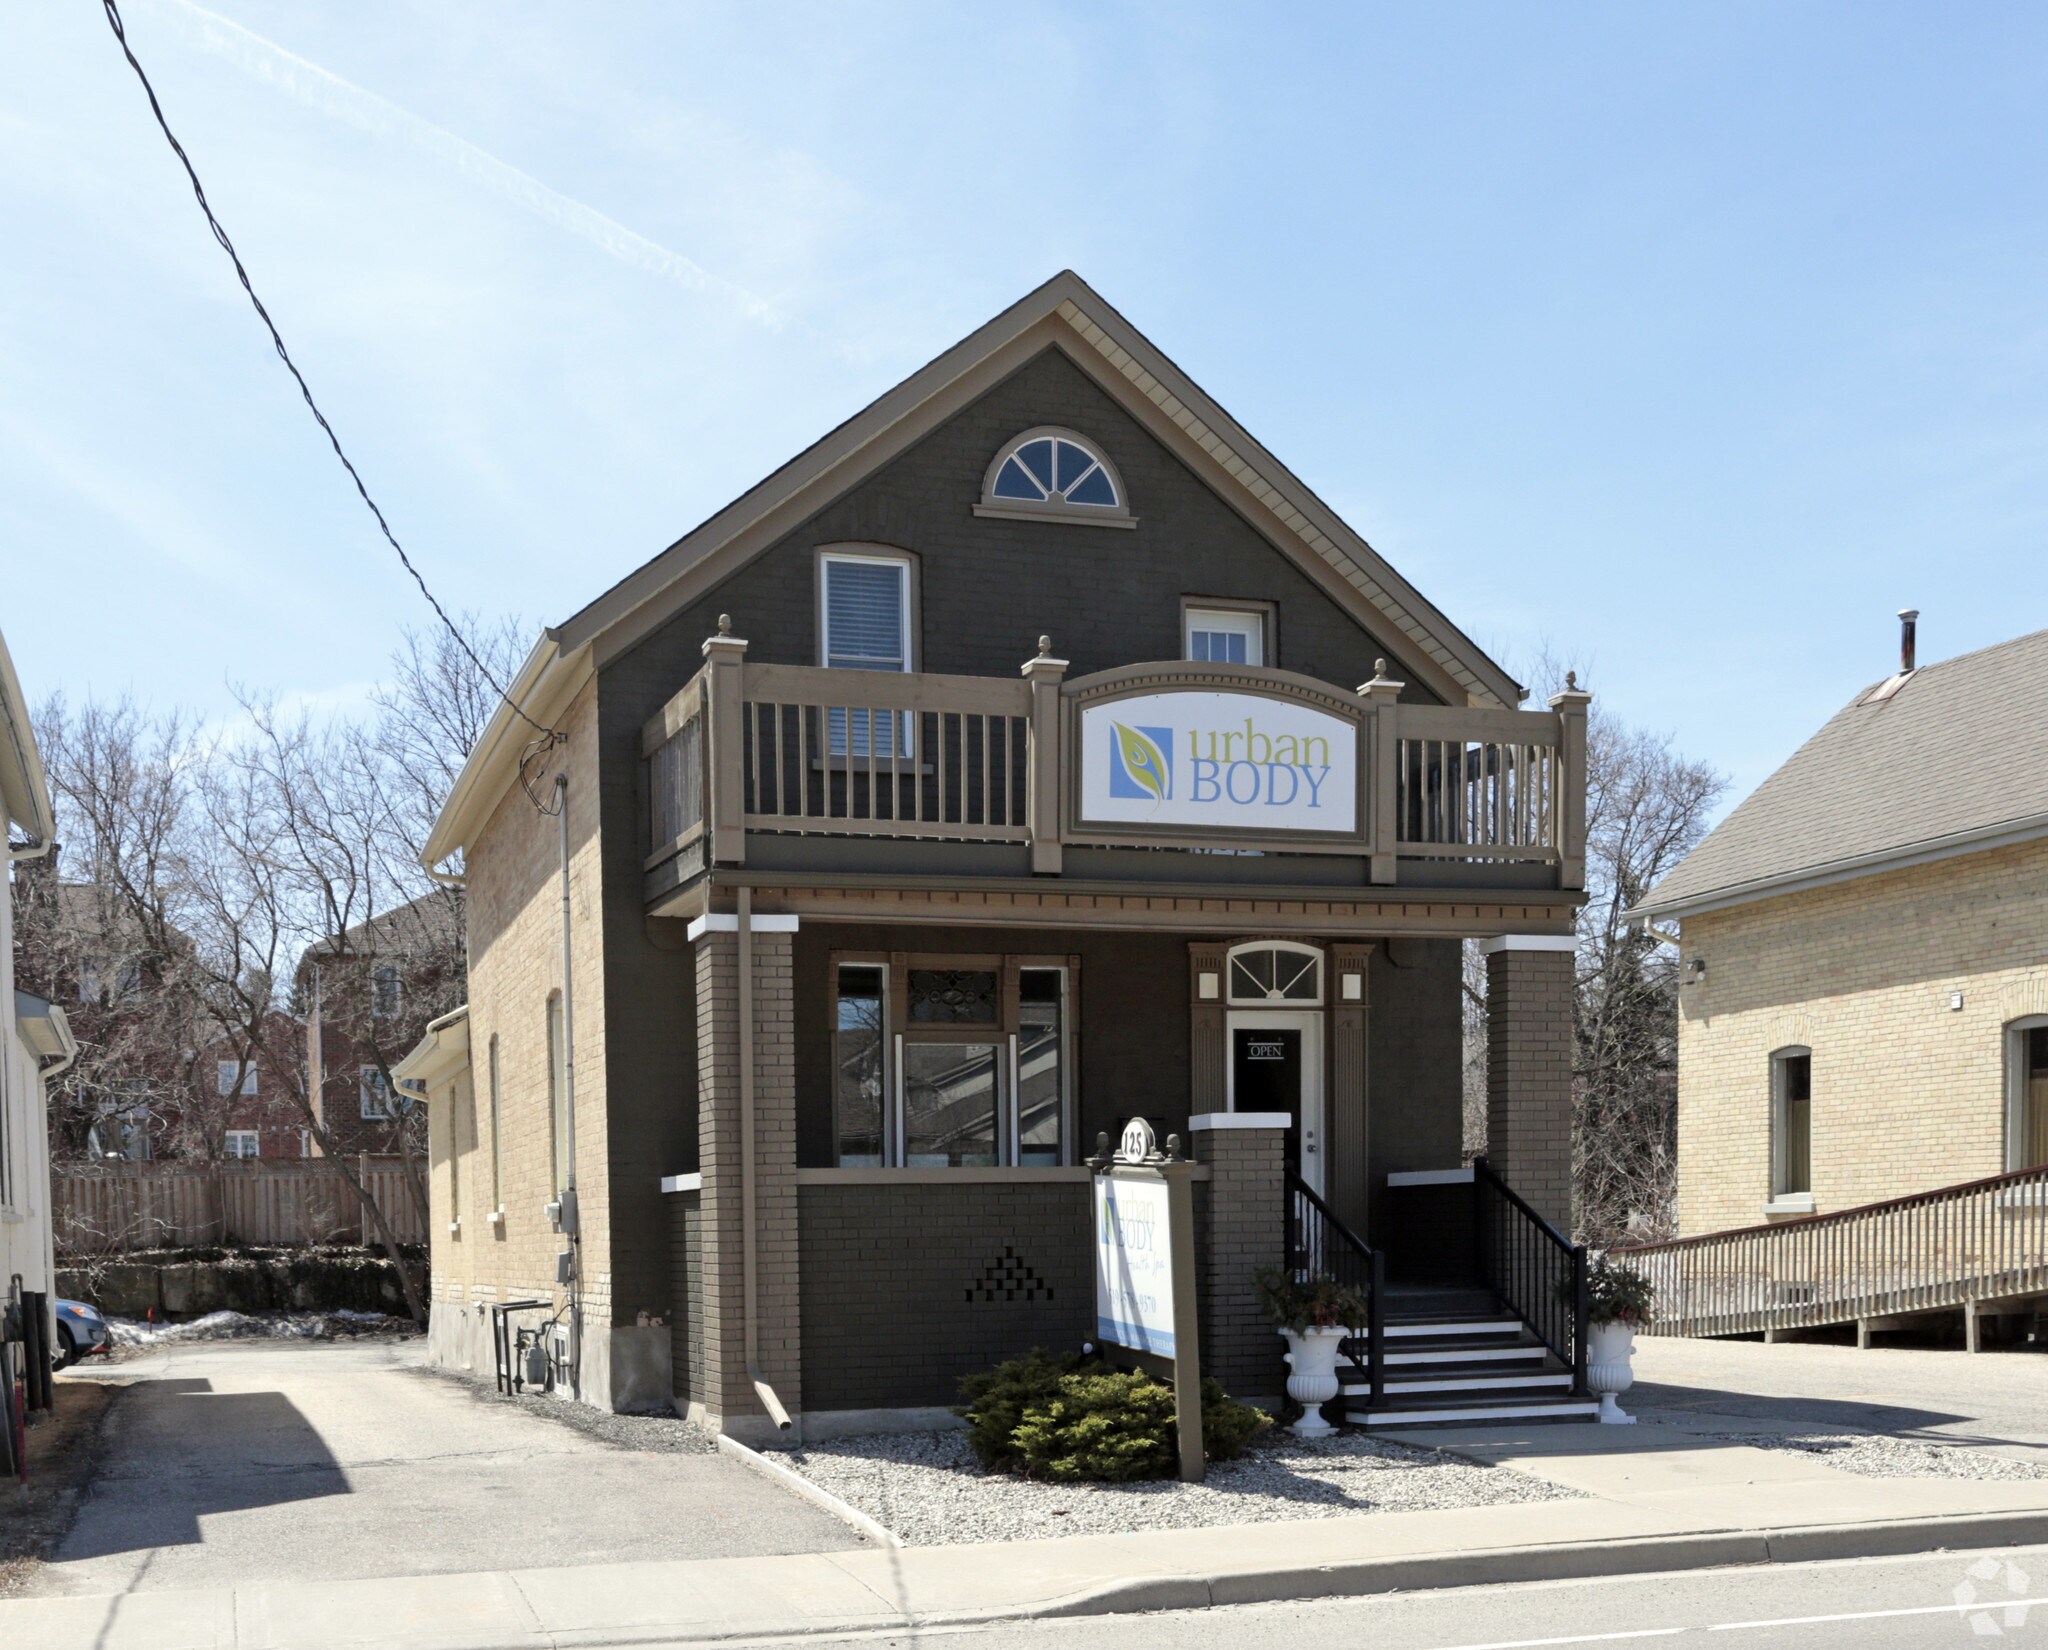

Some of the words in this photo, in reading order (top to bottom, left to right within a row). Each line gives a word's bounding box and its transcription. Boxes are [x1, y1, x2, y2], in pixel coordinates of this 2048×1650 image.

[1188, 717, 1329, 767] urban
[1189, 758, 1331, 808] BODY
[1250, 1045, 1281, 1056] OPEN
[1124, 1132, 1142, 1157] 125
[1117, 1190, 1154, 1223] urban
[1117, 1217, 1155, 1251] BODY
